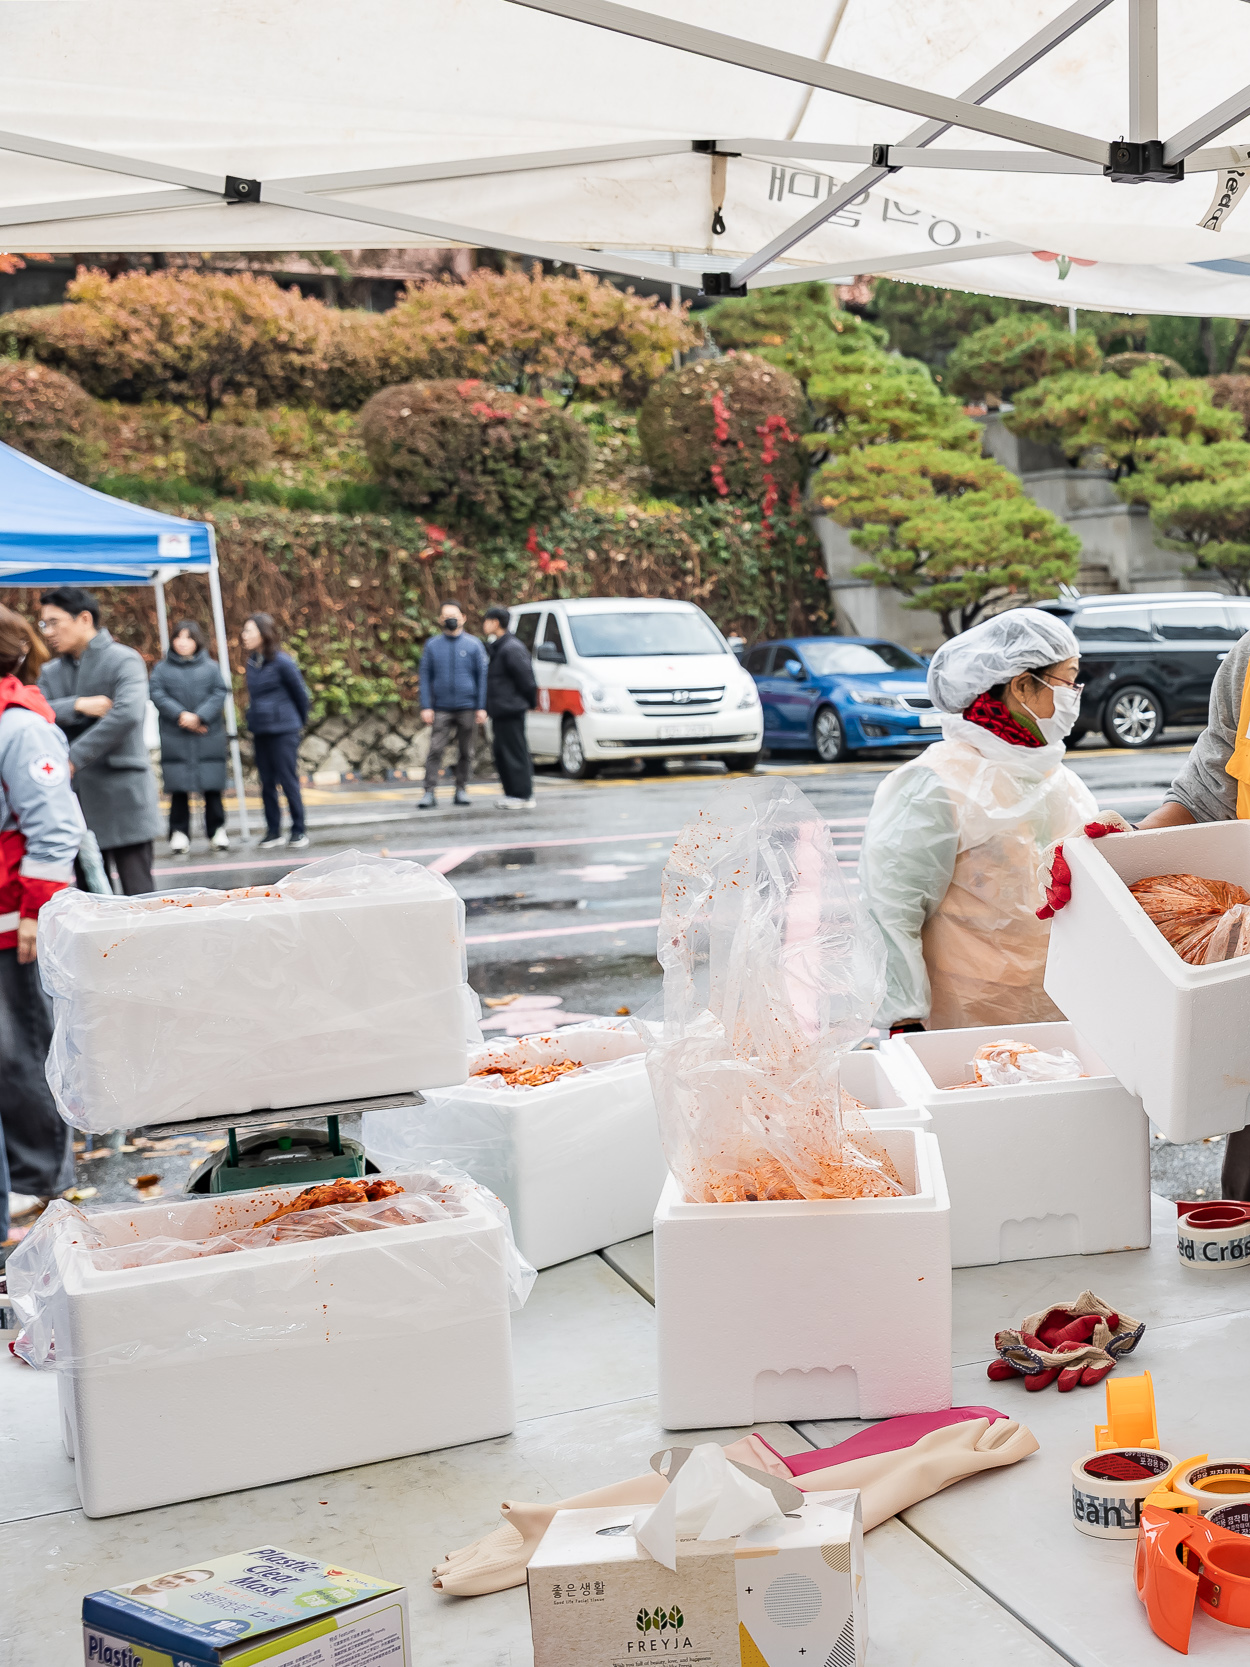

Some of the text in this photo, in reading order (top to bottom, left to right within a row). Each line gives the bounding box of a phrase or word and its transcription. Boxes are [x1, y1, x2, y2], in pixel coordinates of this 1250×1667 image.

[249, 1549, 320, 1573] Plastic
[247, 1565, 301, 1583] Clear
[229, 1576, 289, 1597] Mask
[551, 1580, 606, 1599] 좋은생활
[88, 1634, 143, 1667] Plastic
[626, 1636, 693, 1653] FREYJA
